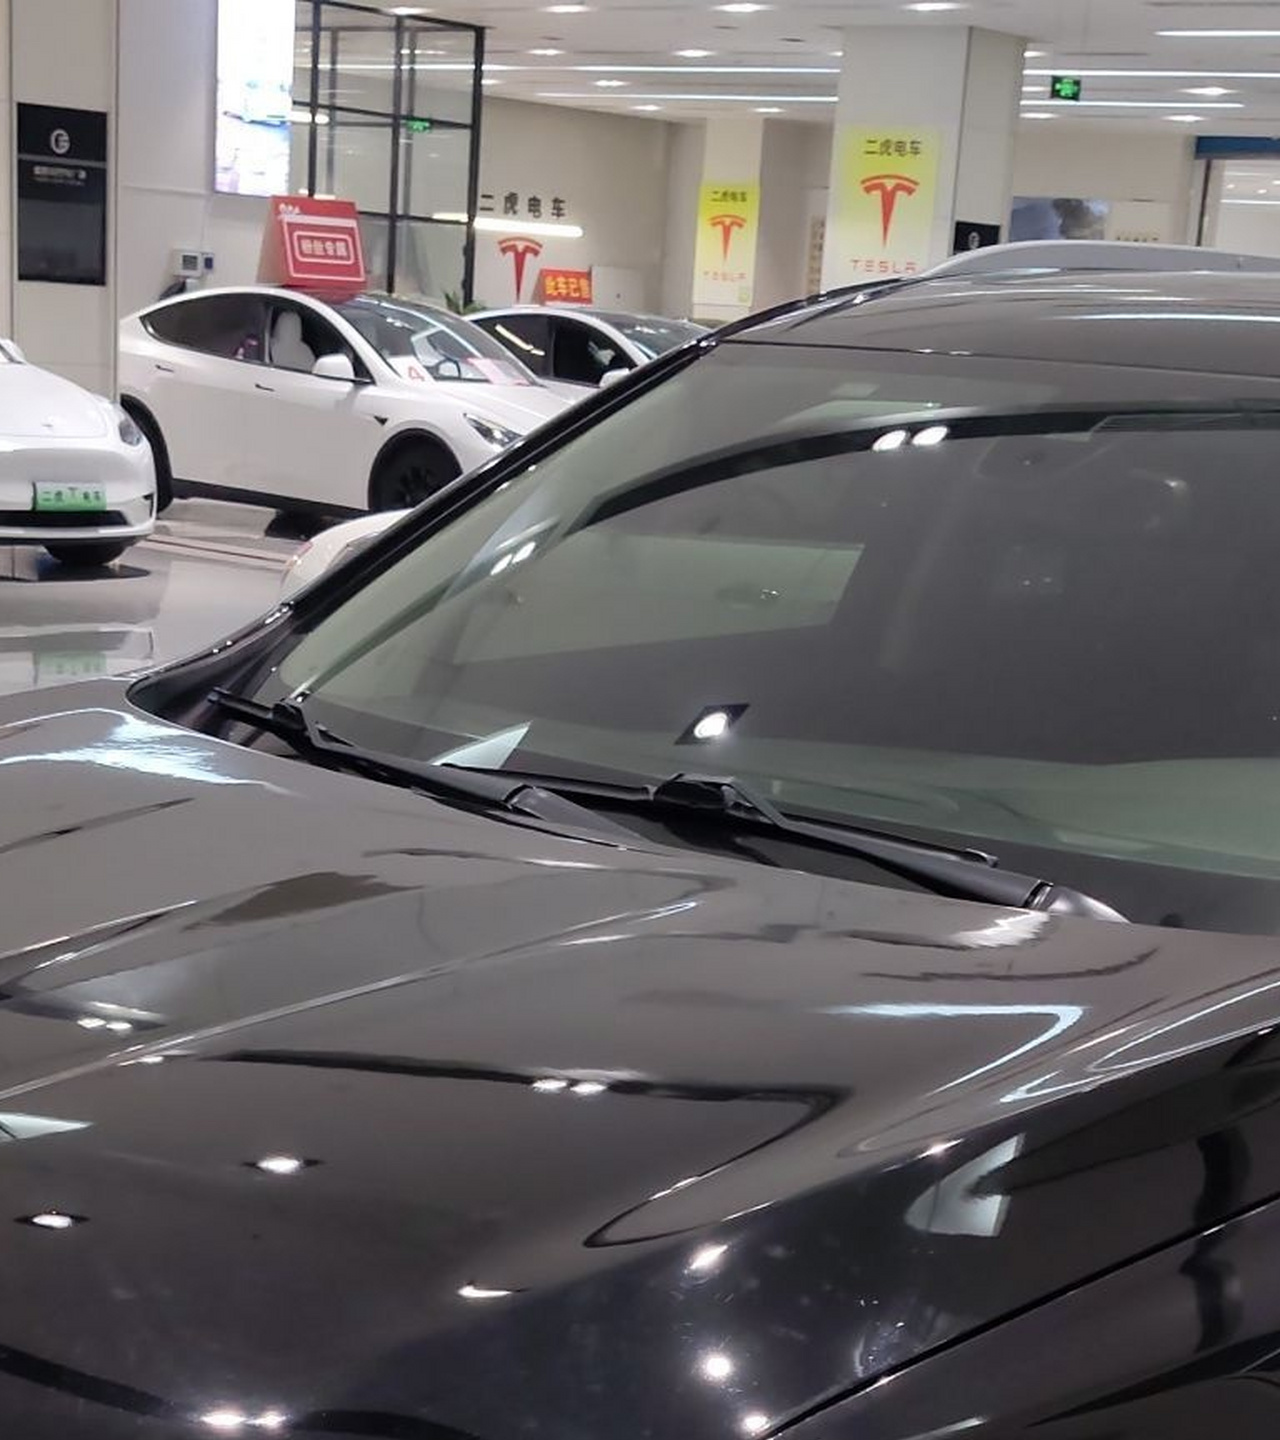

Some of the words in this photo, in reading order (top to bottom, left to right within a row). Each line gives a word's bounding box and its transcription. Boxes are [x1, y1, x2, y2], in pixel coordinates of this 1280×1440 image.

[863, 138, 922, 157] 二虎电车
[479, 191, 566, 219] 二虎电车
[850, 258, 919, 275] TESLA
